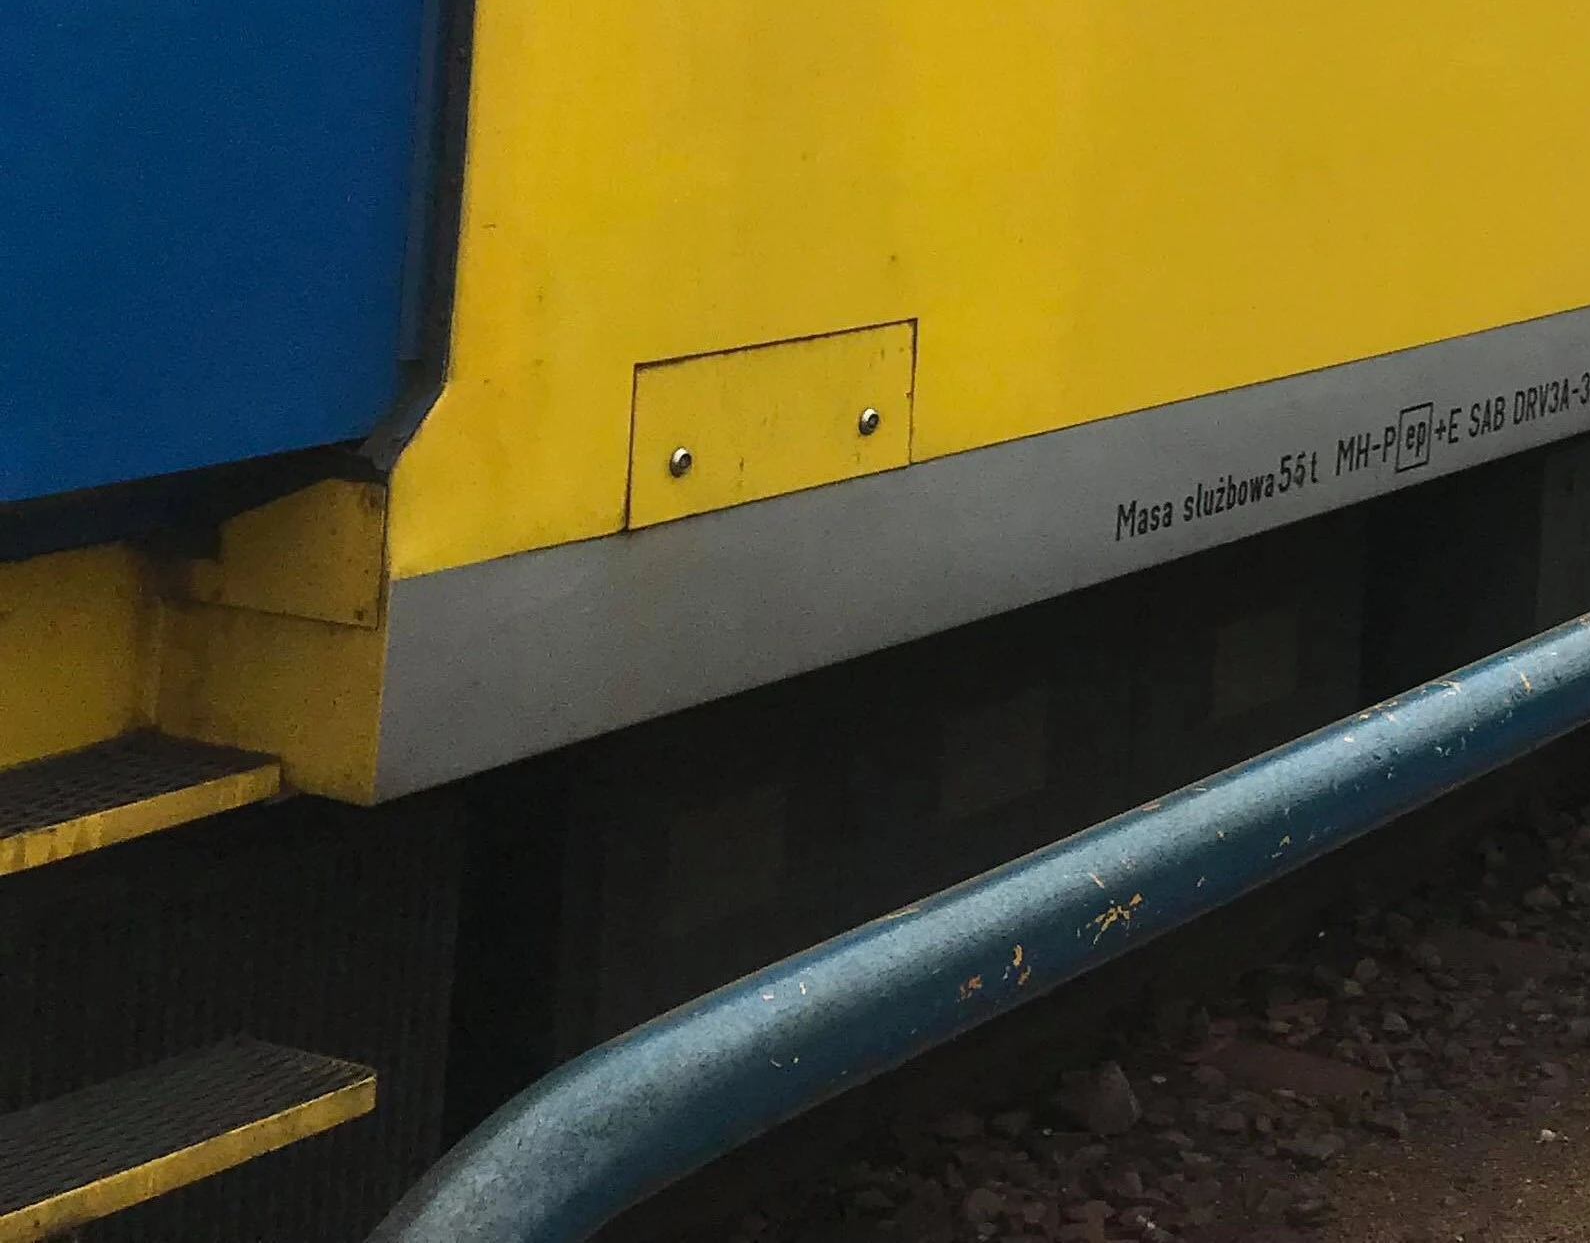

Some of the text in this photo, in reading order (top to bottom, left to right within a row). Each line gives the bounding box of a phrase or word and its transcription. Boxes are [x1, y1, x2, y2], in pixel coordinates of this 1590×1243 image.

[1115, 499, 1172, 541] Masa
[1335, 424, 1397, 476] MH-P
[1468, 395, 1506, 437] SAB
